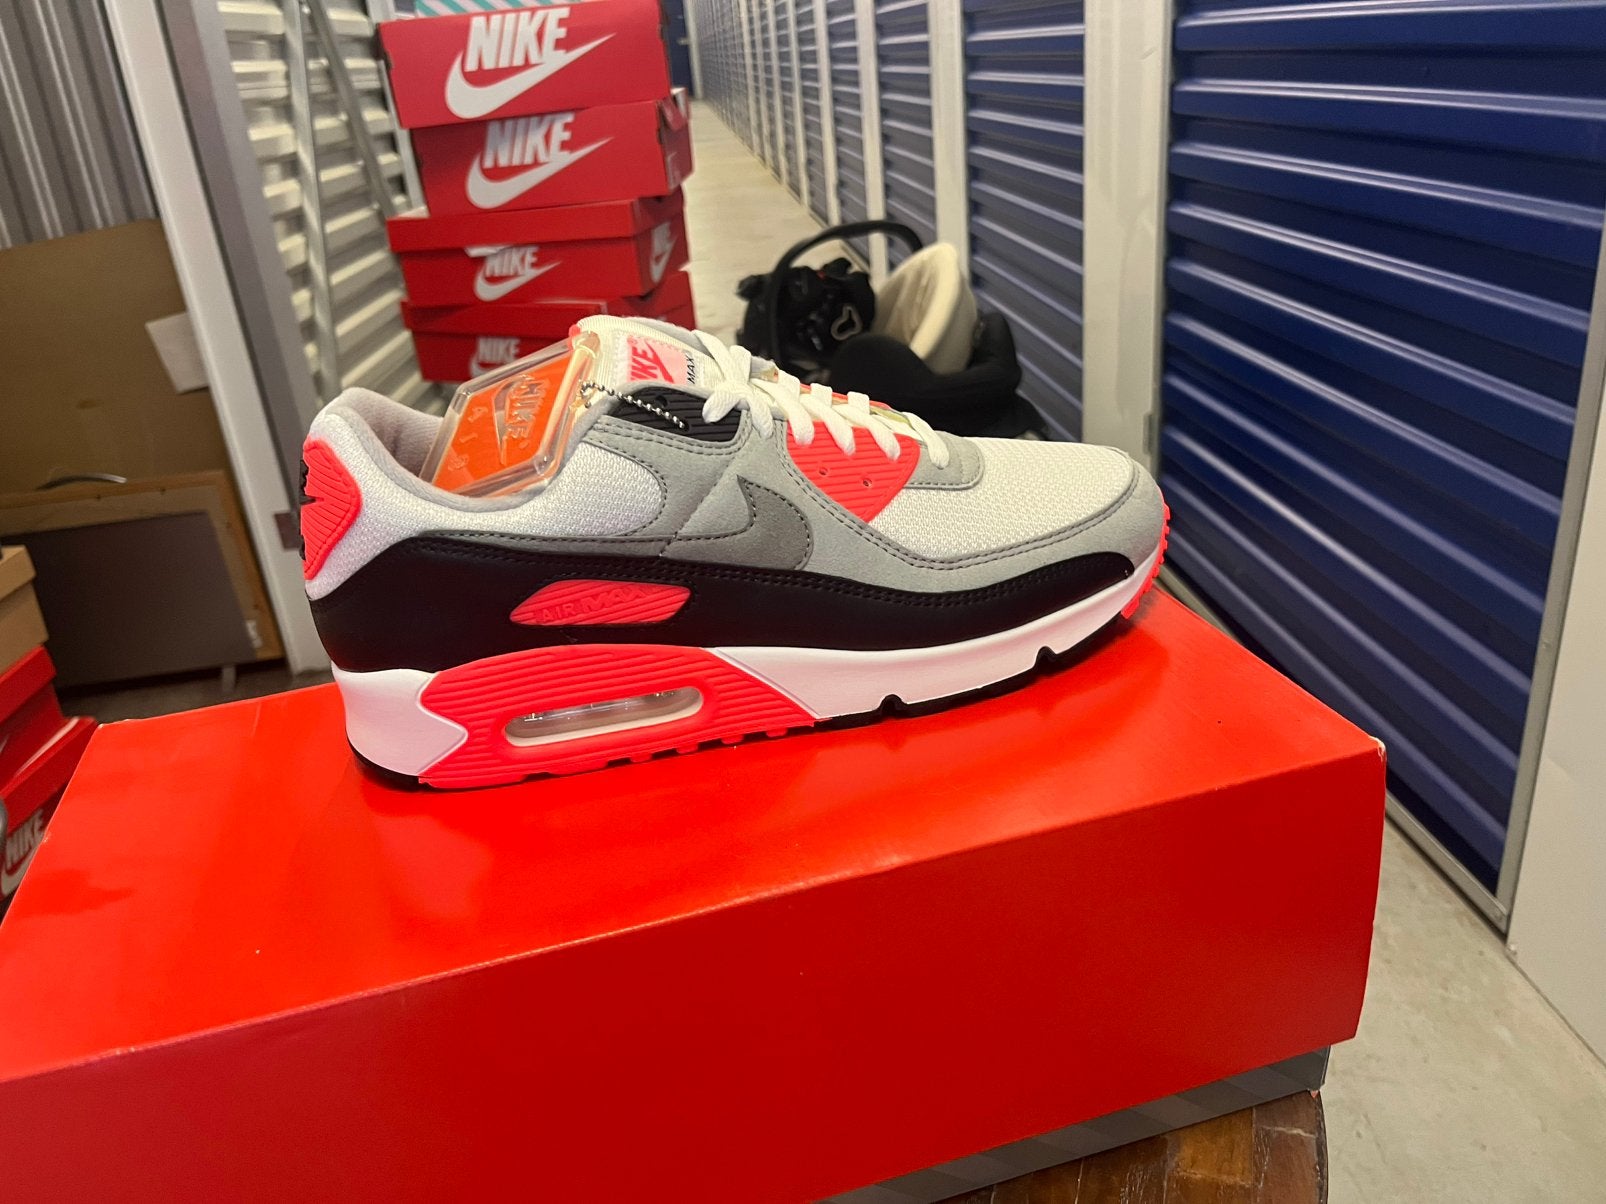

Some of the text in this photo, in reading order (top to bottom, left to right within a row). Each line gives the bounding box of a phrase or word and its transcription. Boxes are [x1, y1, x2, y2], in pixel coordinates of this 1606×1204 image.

[464, 8, 571, 72] NIKE
[483, 112, 575, 169] NIKE
[485, 246, 539, 276] NIKE
[478, 336, 520, 363] NIKE
[685, 355, 696, 384] MAX
[540, 585, 648, 622] AIR MAX
